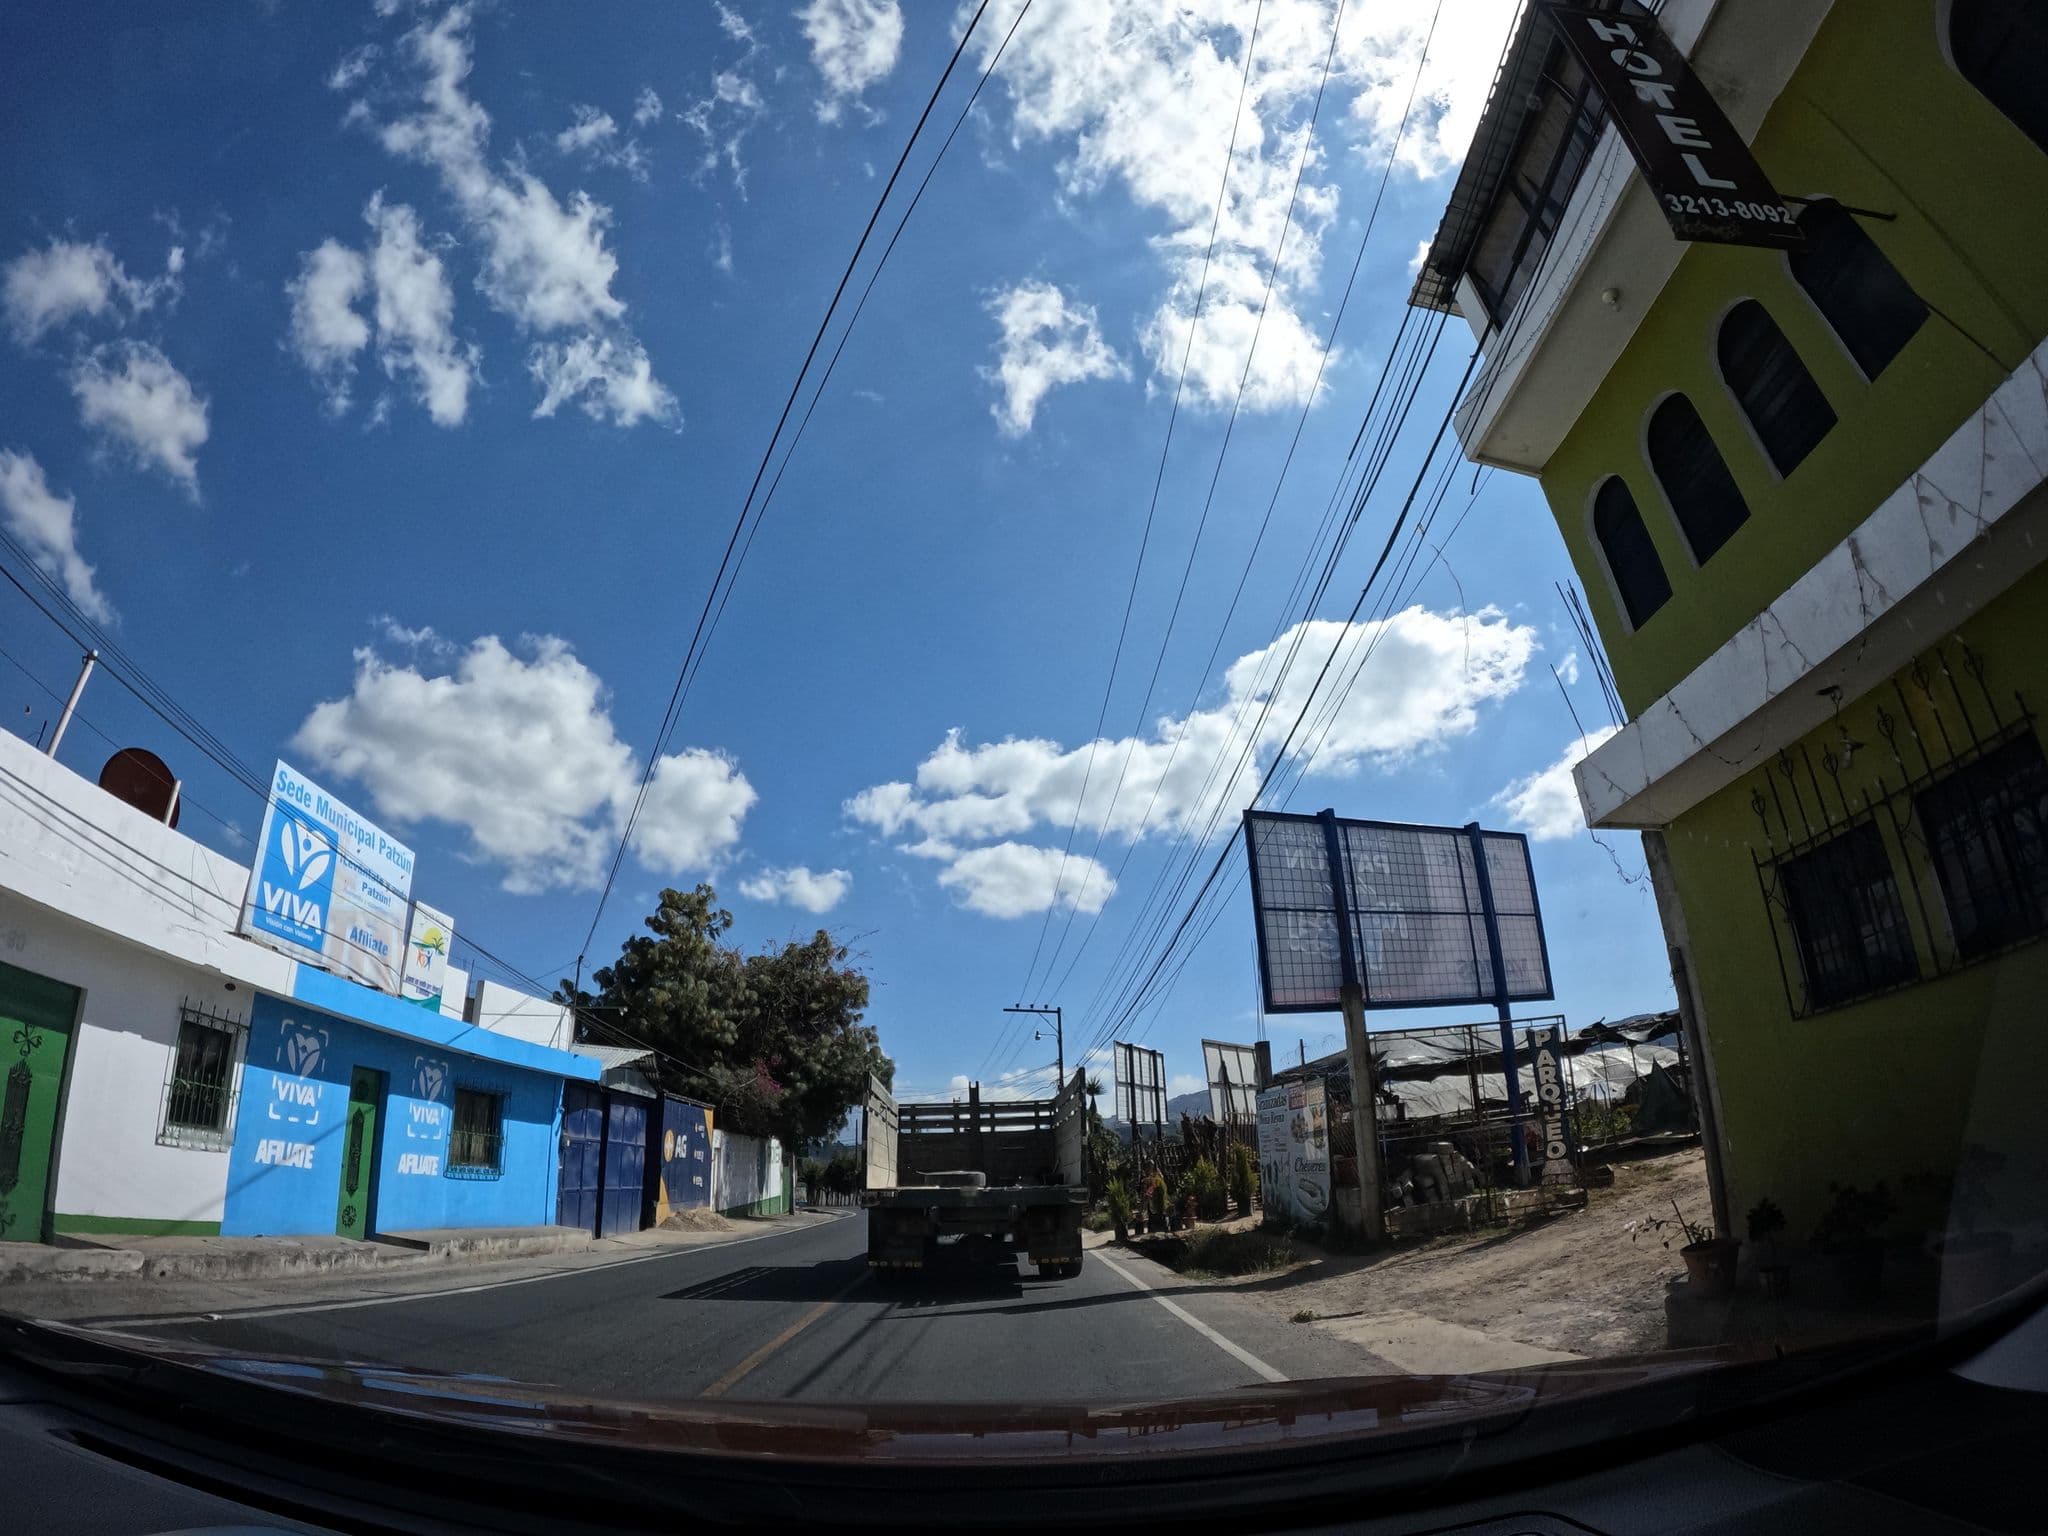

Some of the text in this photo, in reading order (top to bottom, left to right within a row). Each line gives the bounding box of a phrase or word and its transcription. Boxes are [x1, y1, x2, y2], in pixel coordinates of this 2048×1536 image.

[1586, 17, 1738, 191] HOTEL
[1664, 193, 1796, 224] 3213-8092
[276, 770, 312, 808] Sede
[316, 796, 376, 850] Municipal
[263, 881, 321, 935] VIVA
[278, 1079, 316, 1107] VIVA
[412, 1105, 439, 1125] VIVA
[1534, 1030, 1568, 1160] PARQUEO
